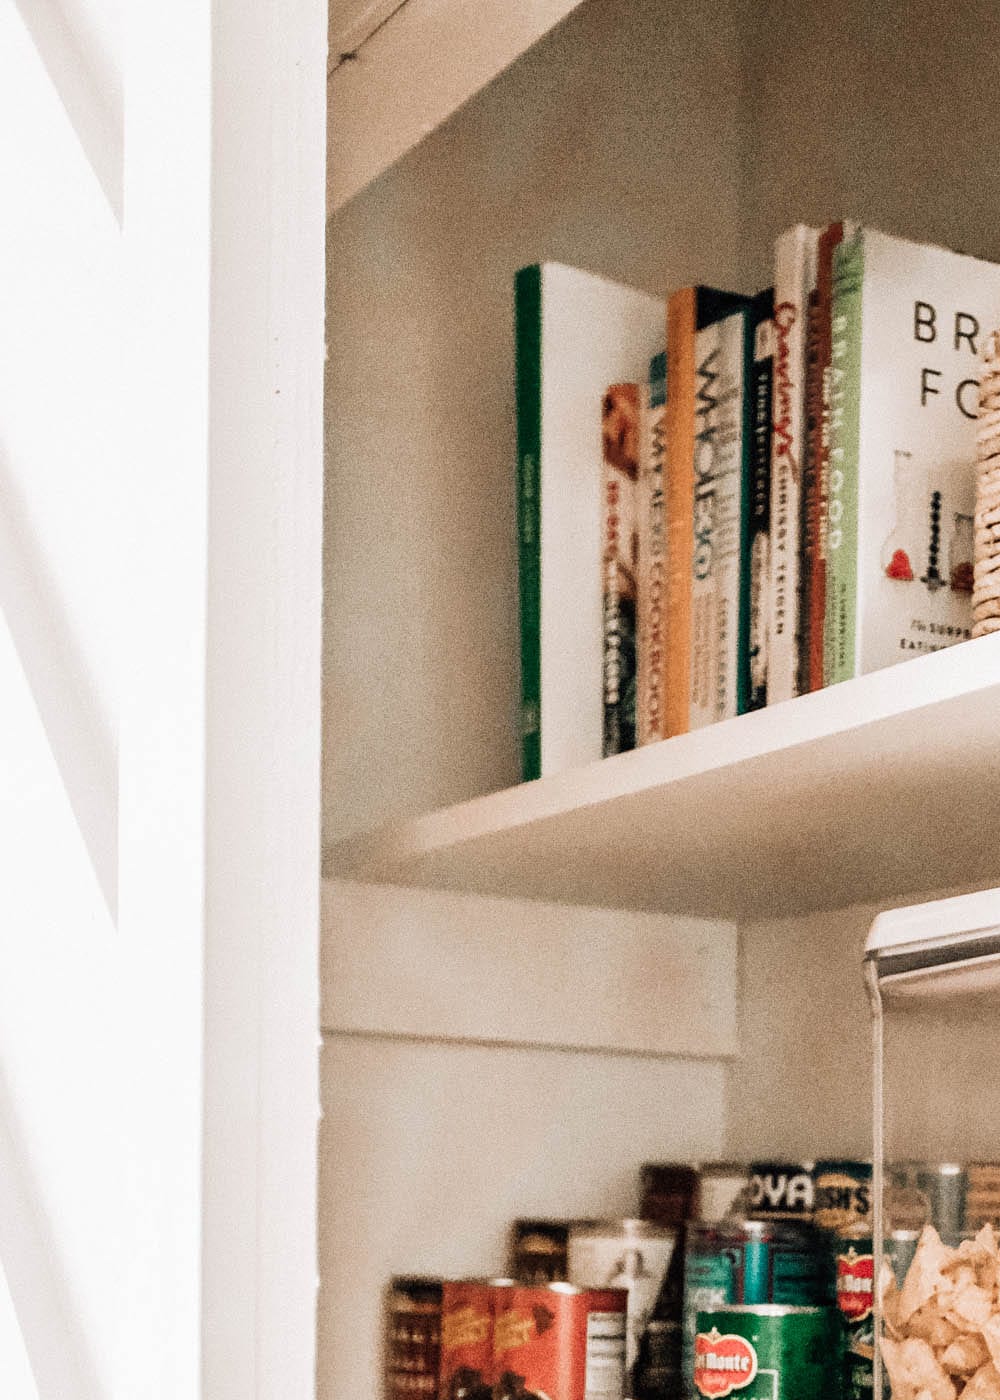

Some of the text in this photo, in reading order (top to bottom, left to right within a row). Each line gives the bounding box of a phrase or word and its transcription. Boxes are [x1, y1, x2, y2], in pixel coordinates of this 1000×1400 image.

[913, 300, 980, 355] BR
[827, 447, 846, 549] FOOD
[706, 1353, 750, 1371] Monte
